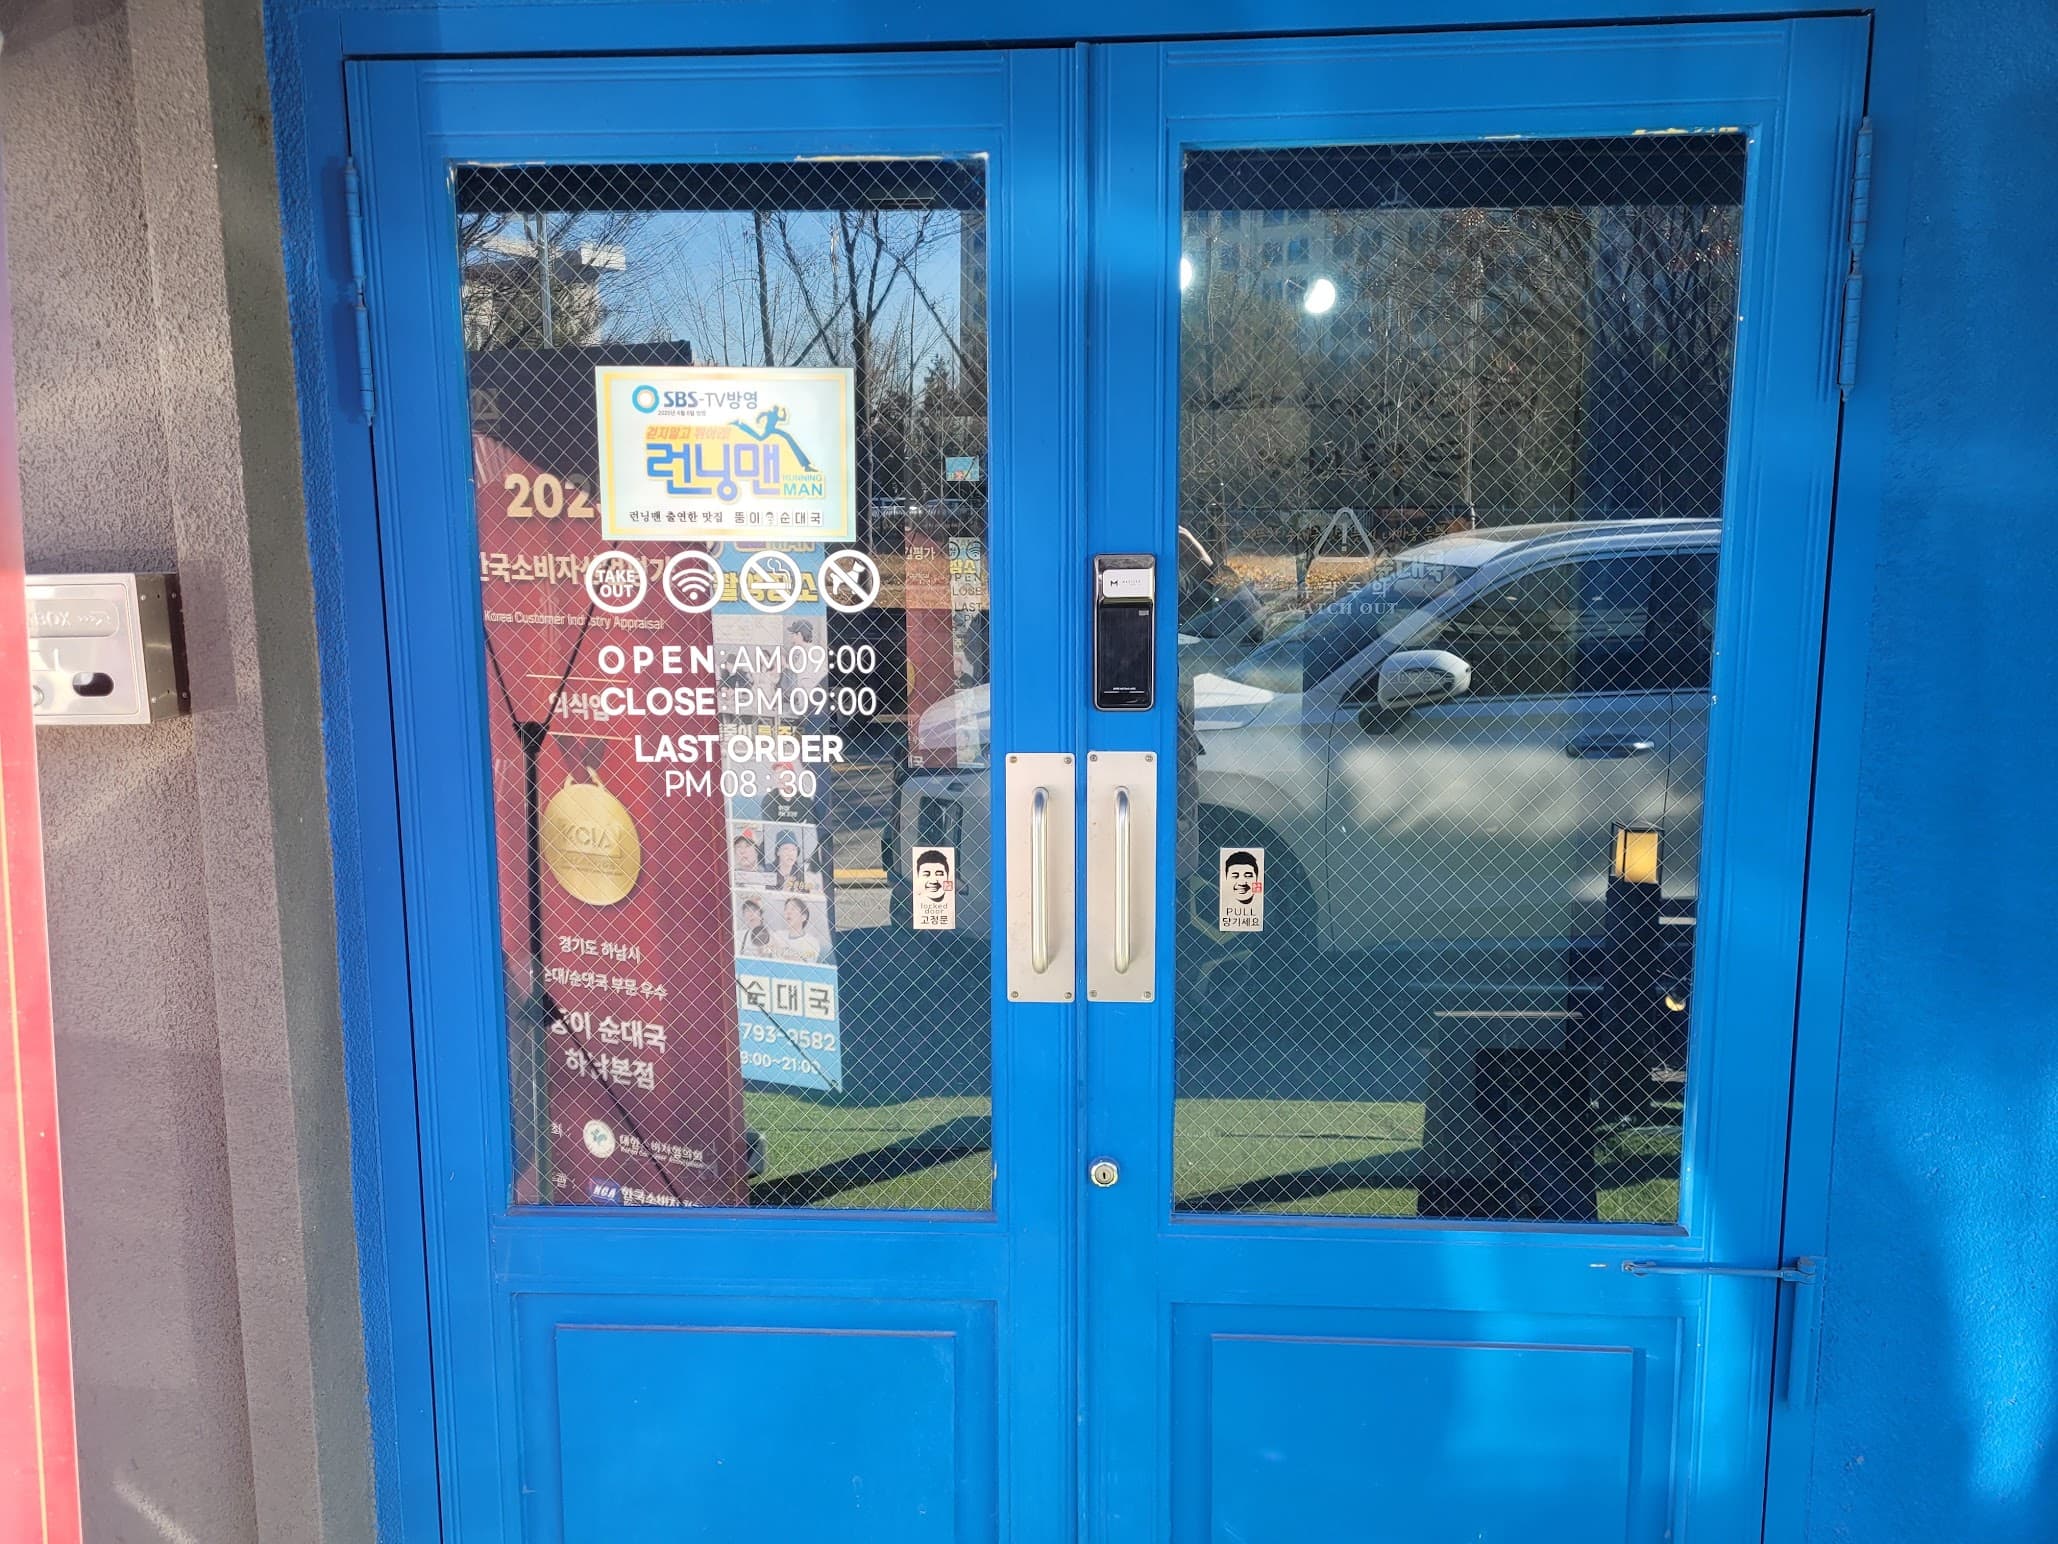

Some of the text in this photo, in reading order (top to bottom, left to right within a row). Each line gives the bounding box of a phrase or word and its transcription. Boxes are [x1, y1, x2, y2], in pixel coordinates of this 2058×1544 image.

[646, 443, 781, 501] 런닝맨
[783, 474, 822, 482] RUNNING
[504, 473, 602, 518] 202
[783, 483, 823, 497] MAN
[629, 511, 661, 523] 런닝맨
[665, 511, 698, 523] 출연한
[702, 511, 723, 523] 맛집
[597, 570, 635, 583] TAKE
[600, 584, 633, 597] OUT
[484, 611, 513, 623] Korea
[732, 646, 782, 674] AM
[788, 645, 876, 674] 09:00
[734, 688, 783, 715] PM
[789, 687, 877, 716] 09:00
[634, 734, 845, 763] LAST ORDER
[665, 770, 712, 797] PM
[920, 915, 949, 925] 고정문
[1222, 917, 1260, 927] 당기세요
[1226, 907, 1257, 916] PULL
[559, 935, 641, 964] 경기도 하남시
[612, 976, 638, 997] 부문
[640, 981, 668, 1001] 우수
[745, 980, 831, 1015] 순대국
[598, 1015, 667, 1054] 순대국
